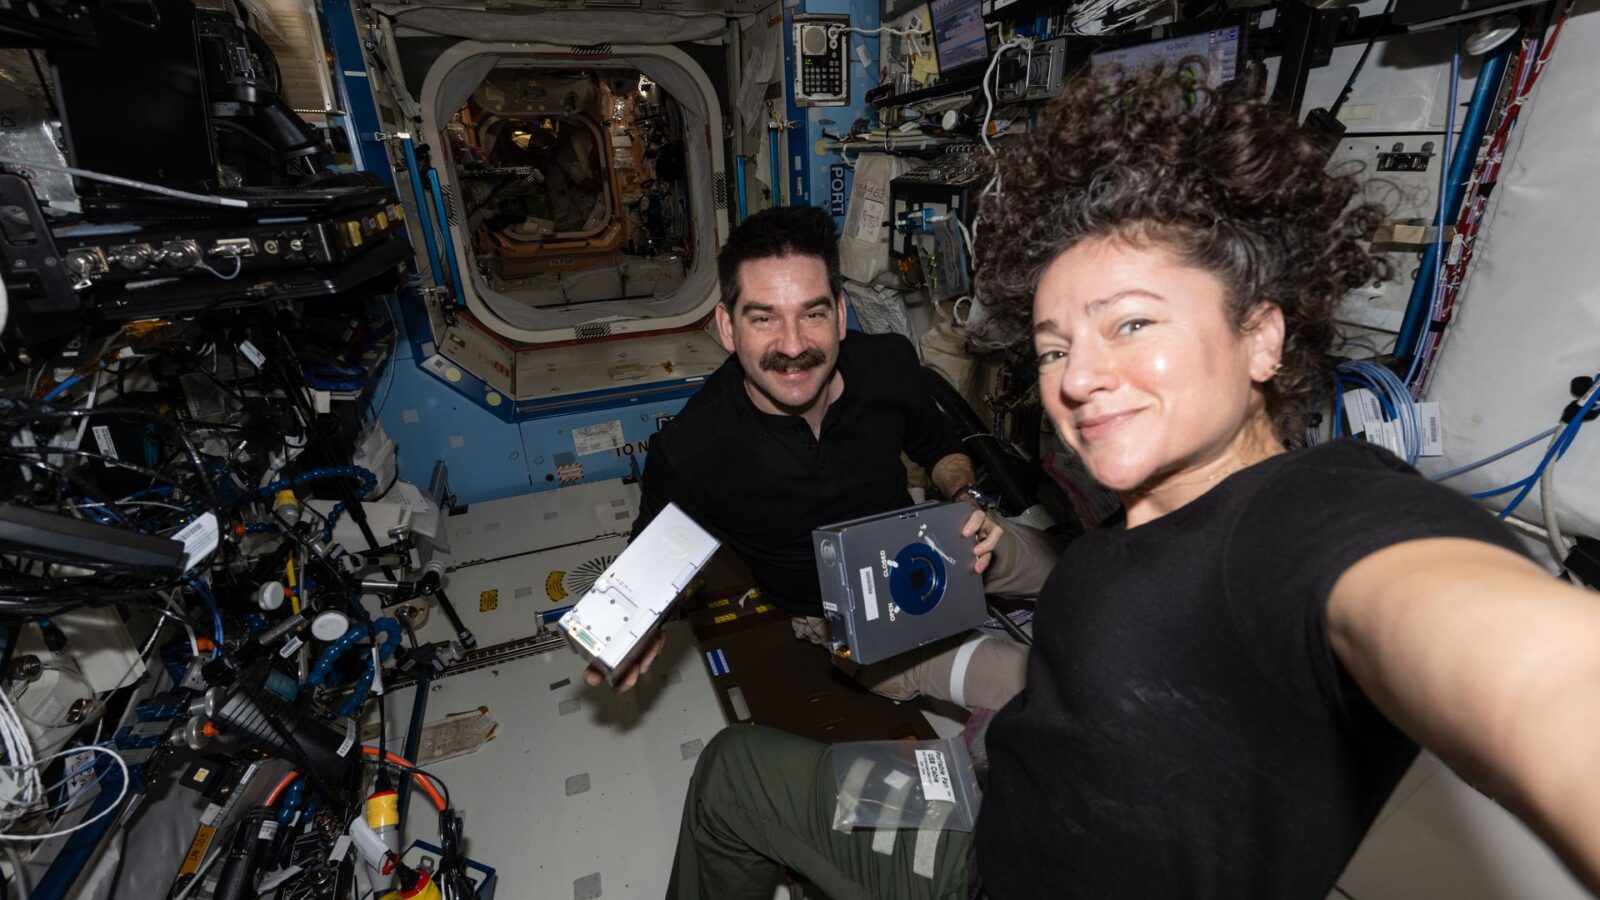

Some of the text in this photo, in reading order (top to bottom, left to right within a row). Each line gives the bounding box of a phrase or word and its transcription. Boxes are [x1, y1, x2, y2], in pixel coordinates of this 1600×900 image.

[831, 167, 844, 214] PORT
[880, 550, 889, 578] CLOSED
[888, 602, 896, 622] OPEN
[927, 753, 936, 764] USB
[936, 751, 945, 775] Portable
[930, 766, 939, 783] Cable
